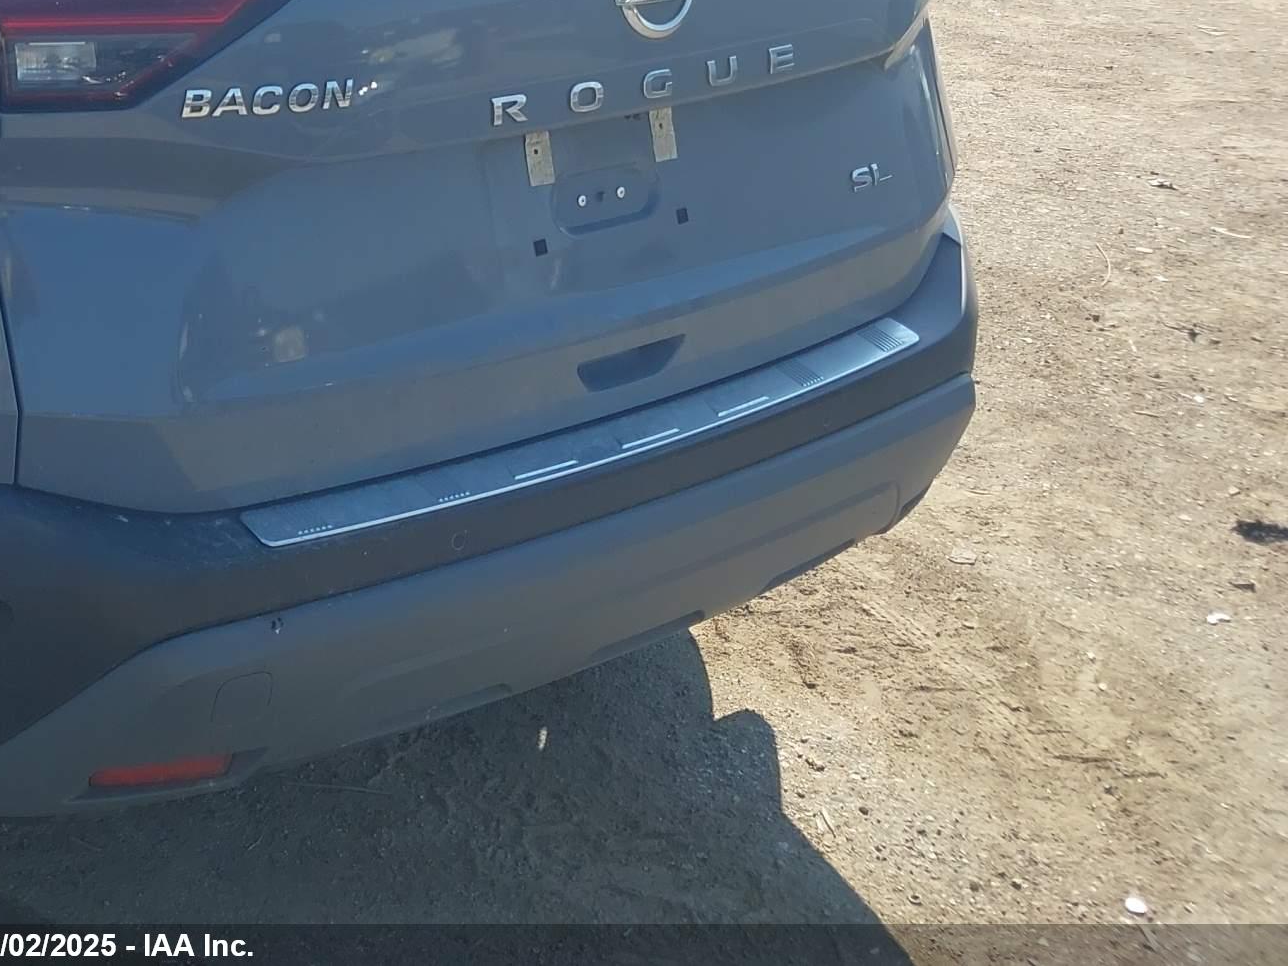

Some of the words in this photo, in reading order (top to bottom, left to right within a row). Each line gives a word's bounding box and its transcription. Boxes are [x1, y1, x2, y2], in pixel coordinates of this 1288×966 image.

[181, 78, 353, 119] BACON
[491, 43, 795, 126] ROGUE
[851, 163, 893, 193] SL
